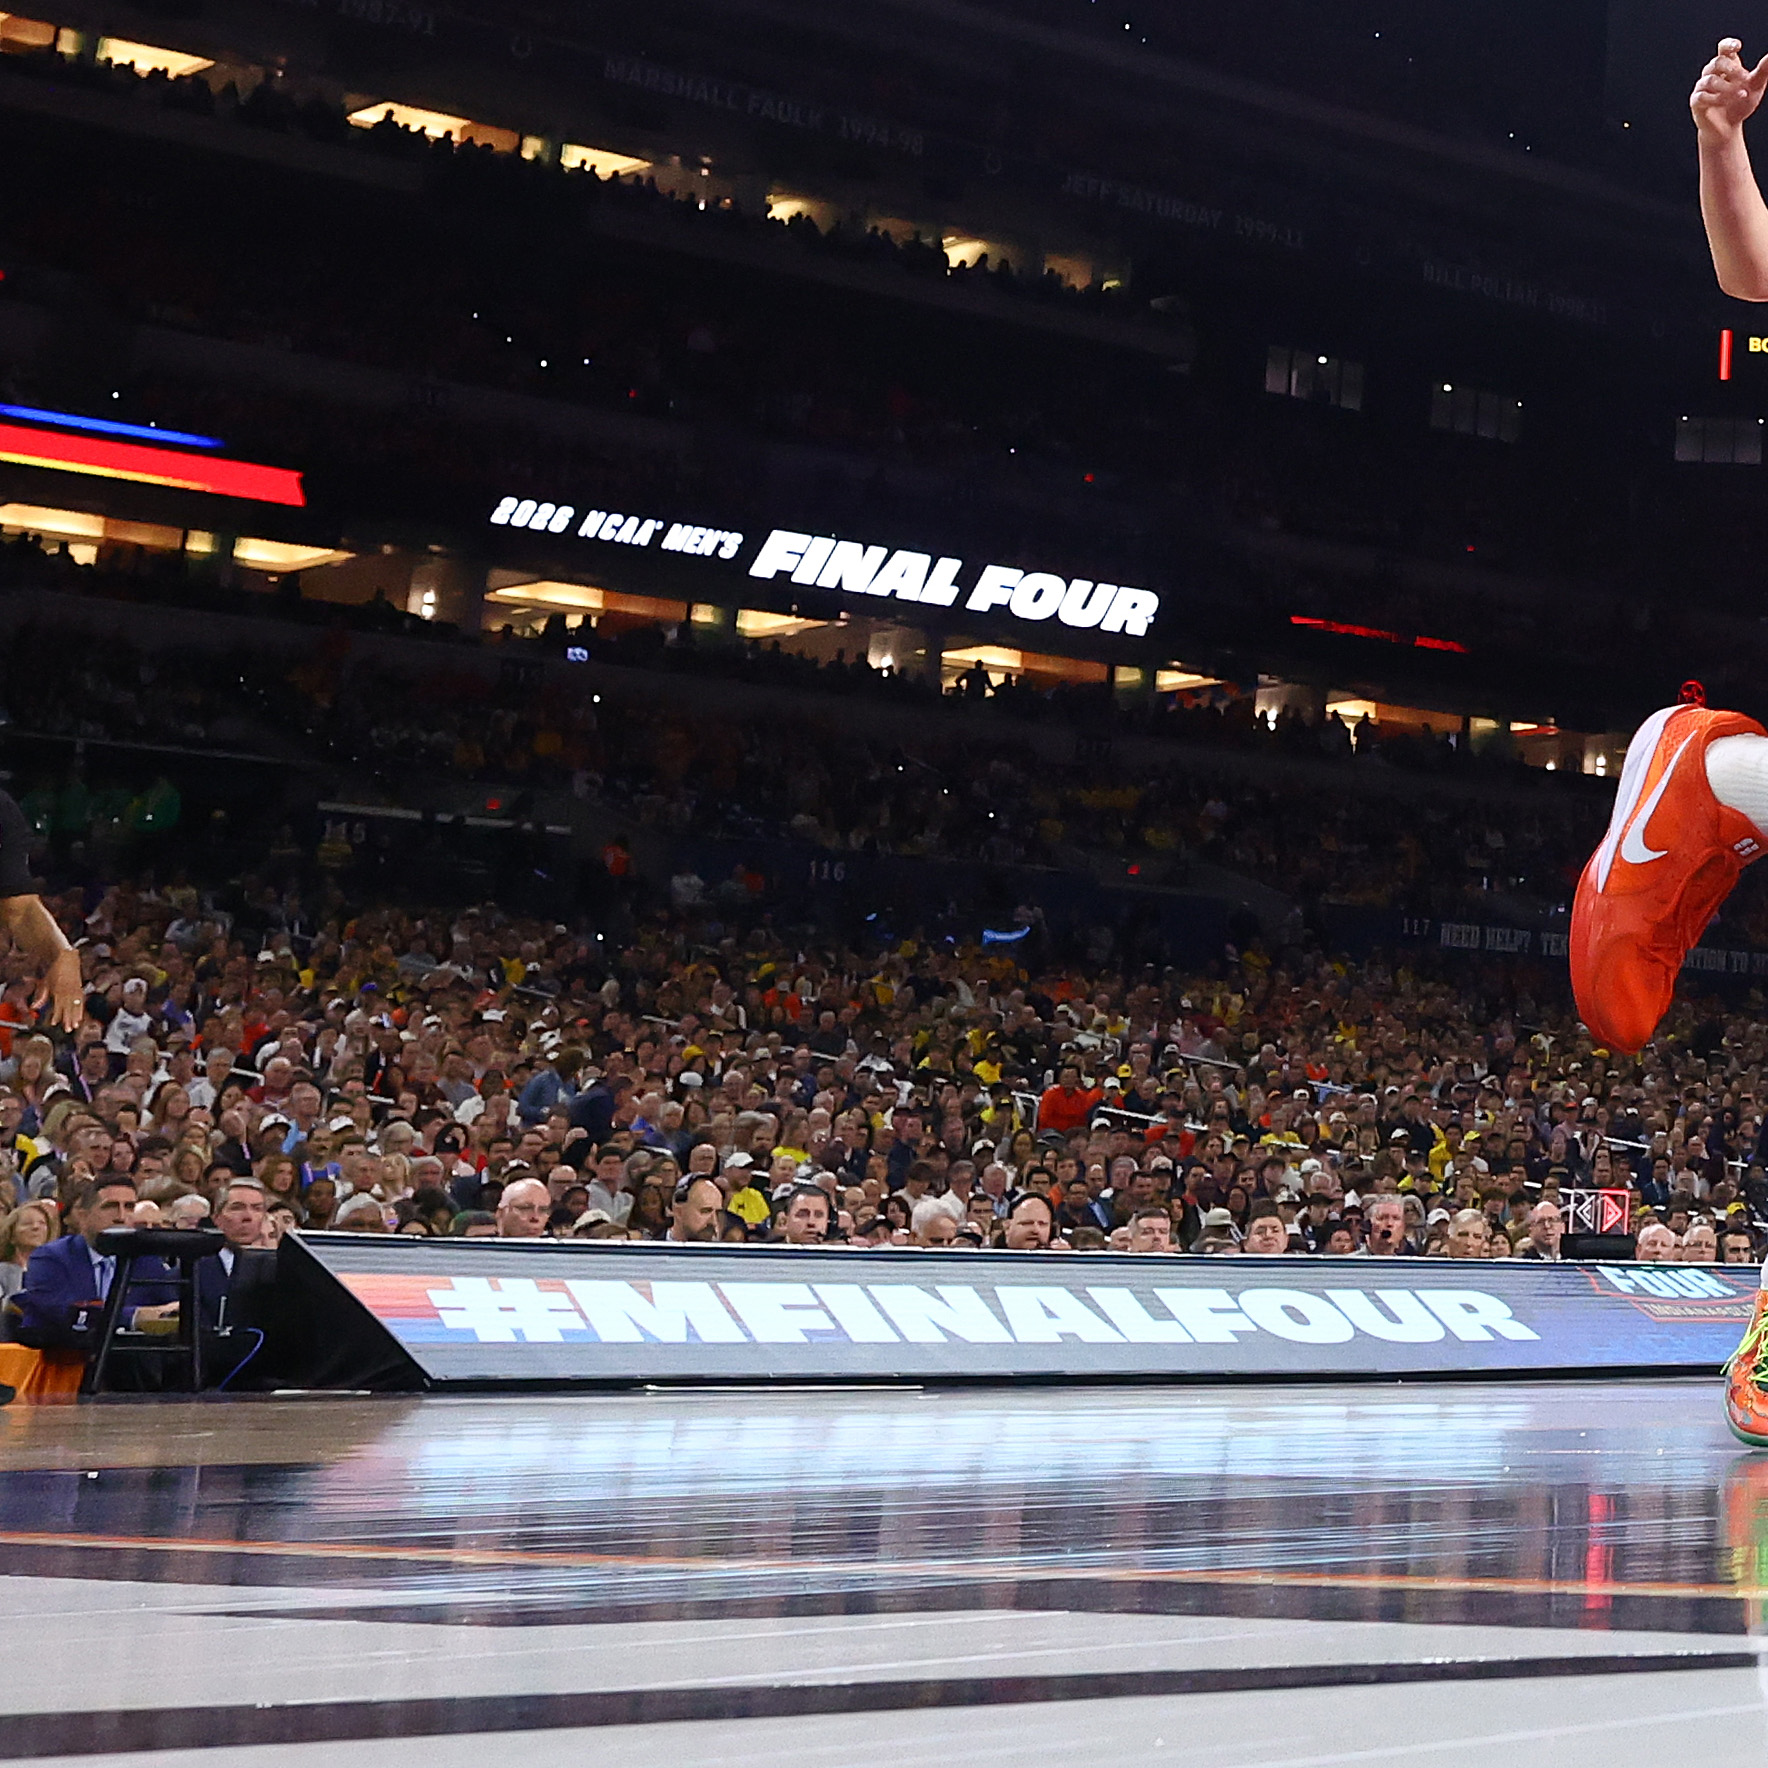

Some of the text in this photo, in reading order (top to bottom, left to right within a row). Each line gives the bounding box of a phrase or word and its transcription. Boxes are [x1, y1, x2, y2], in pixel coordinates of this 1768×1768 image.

[490, 497, 573, 534] 2026
[661, 523, 743, 560] MEN'S
[749, 529, 961, 608] FINAL
[965, 563, 1160, 638] FOUR
[428, 1277, 1540, 1343] #MFINALFOUR
[1595, 1265, 1737, 1299] FOUR
